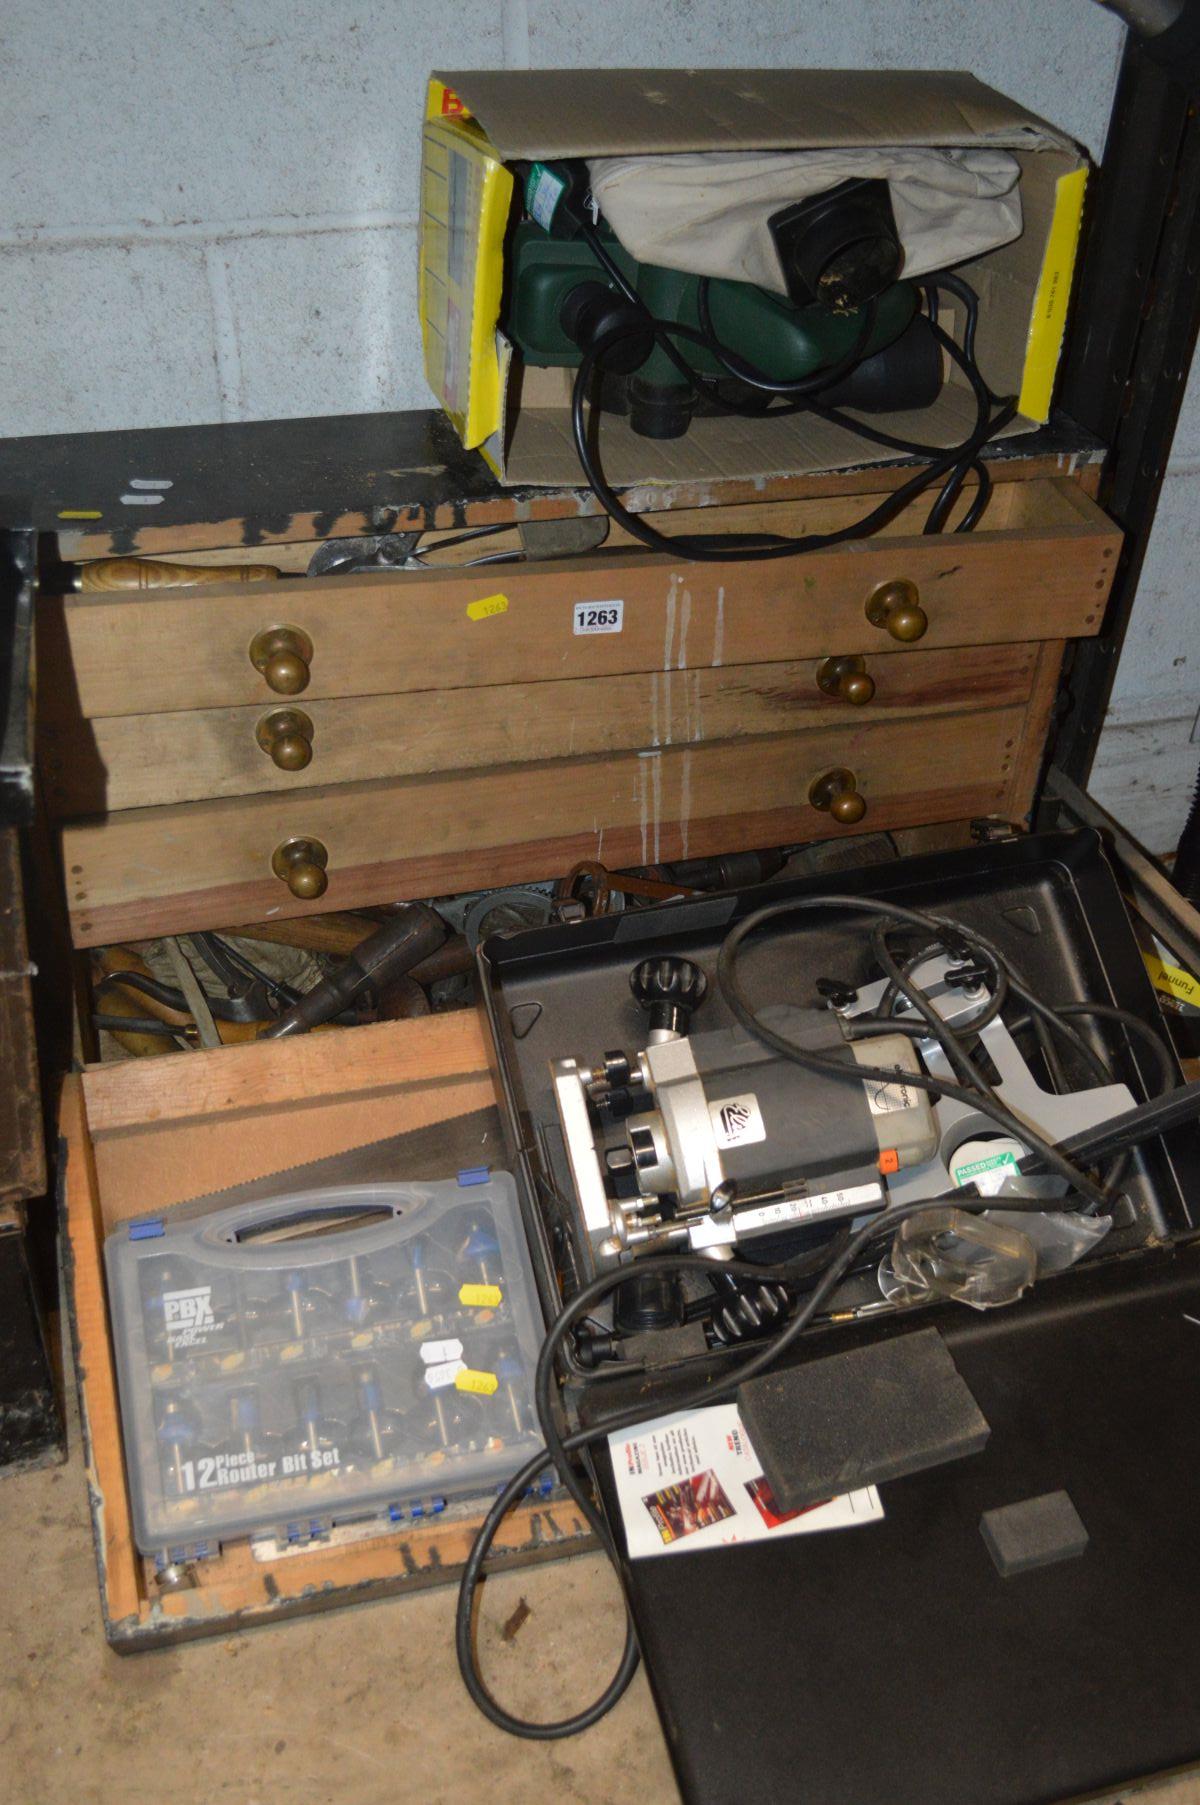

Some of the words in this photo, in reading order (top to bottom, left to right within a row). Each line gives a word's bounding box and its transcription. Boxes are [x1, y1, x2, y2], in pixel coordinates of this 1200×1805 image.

[578, 610, 617, 626] 1263
[1159, 971, 1194, 995] Funnel
[957, 1162, 987, 1176] PASSED
[164, 1295, 214, 1326] PBX
[731, 1429, 742, 1455] TREND
[216, 1452, 255, 1468] Piece
[217, 1461, 277, 1486] Router
[282, 1454, 308, 1474] Bit
[310, 1447, 341, 1468] Set
[182, 1458, 218, 1491] 12
